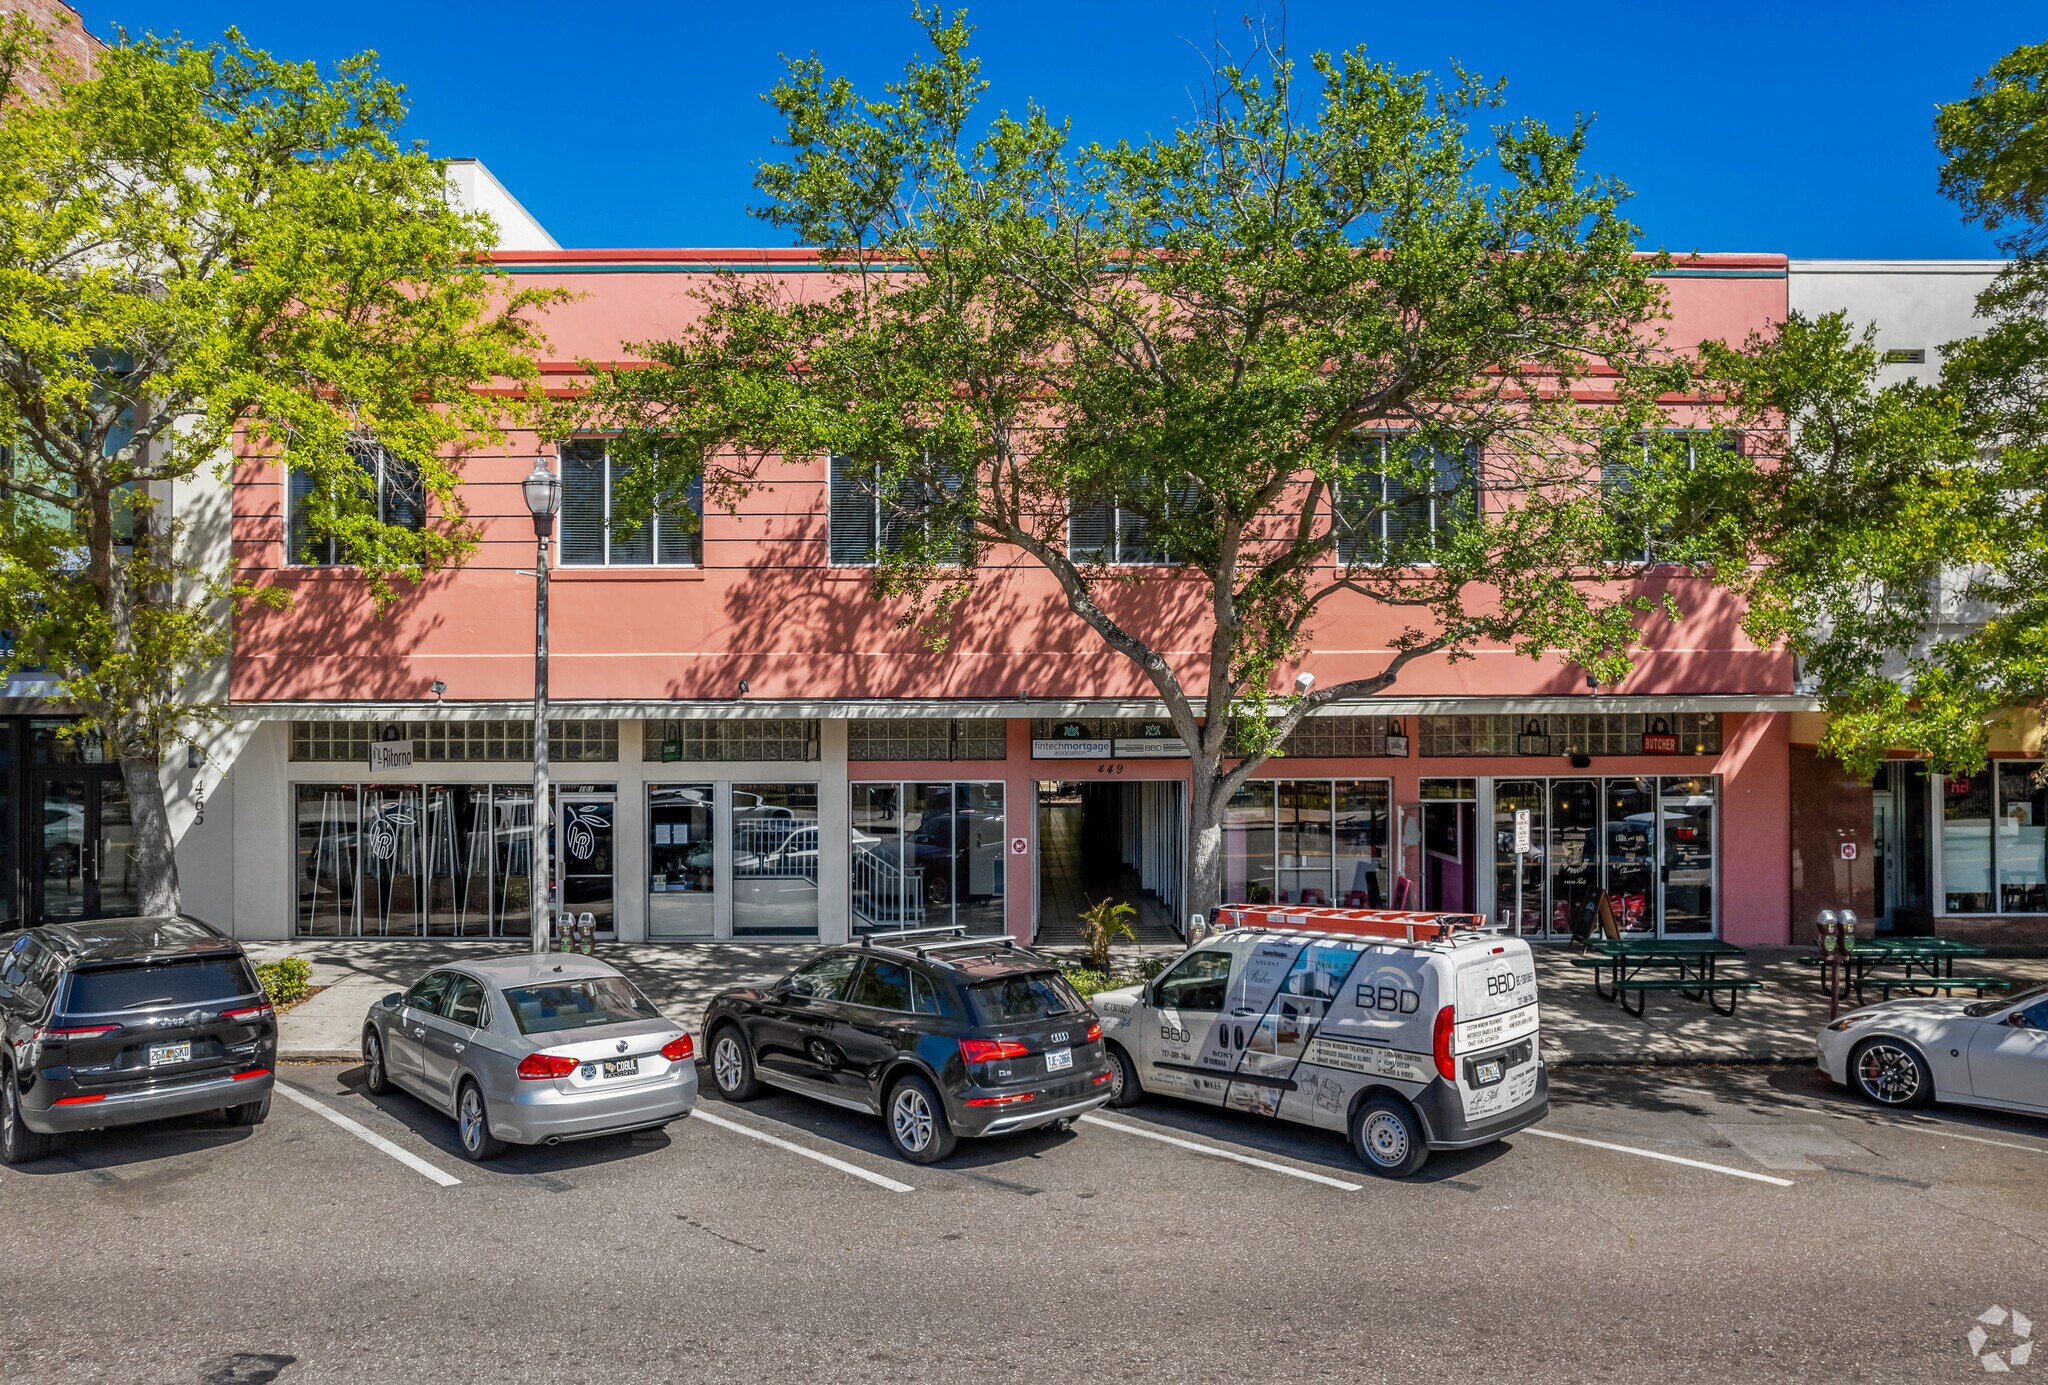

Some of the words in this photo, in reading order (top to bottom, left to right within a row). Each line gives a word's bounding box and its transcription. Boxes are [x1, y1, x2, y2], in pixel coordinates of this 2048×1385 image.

[1034, 741, 1109, 753] fintechmortgage
[1144, 744, 1163, 752] BBD
[1645, 738, 1675, 751] BUTCHER
[383, 747, 412, 768] Ritorno
[1097, 764, 1124, 774] 449
[195, 780, 204, 825] 465
[1487, 972, 1516, 997] BBD
[1355, 983, 1420, 1015] BBD
[1161, 1026, 1191, 1043] BBD
[1316, 1040, 1330, 1048] CUSTOM
[1330, 1042, 1348, 1050] WINDOW
[1349, 1045, 1374, 1054] TREATMENTS
[1212, 1050, 1234, 1060] SONY
[1357, 1055, 1372, 1063] BLINDS
[1403, 1054, 1422, 1063] CONTROL
[1340, 1061, 1364, 1070] AUTOMATION
[1400, 1071, 1414, 1079] VIDEO
